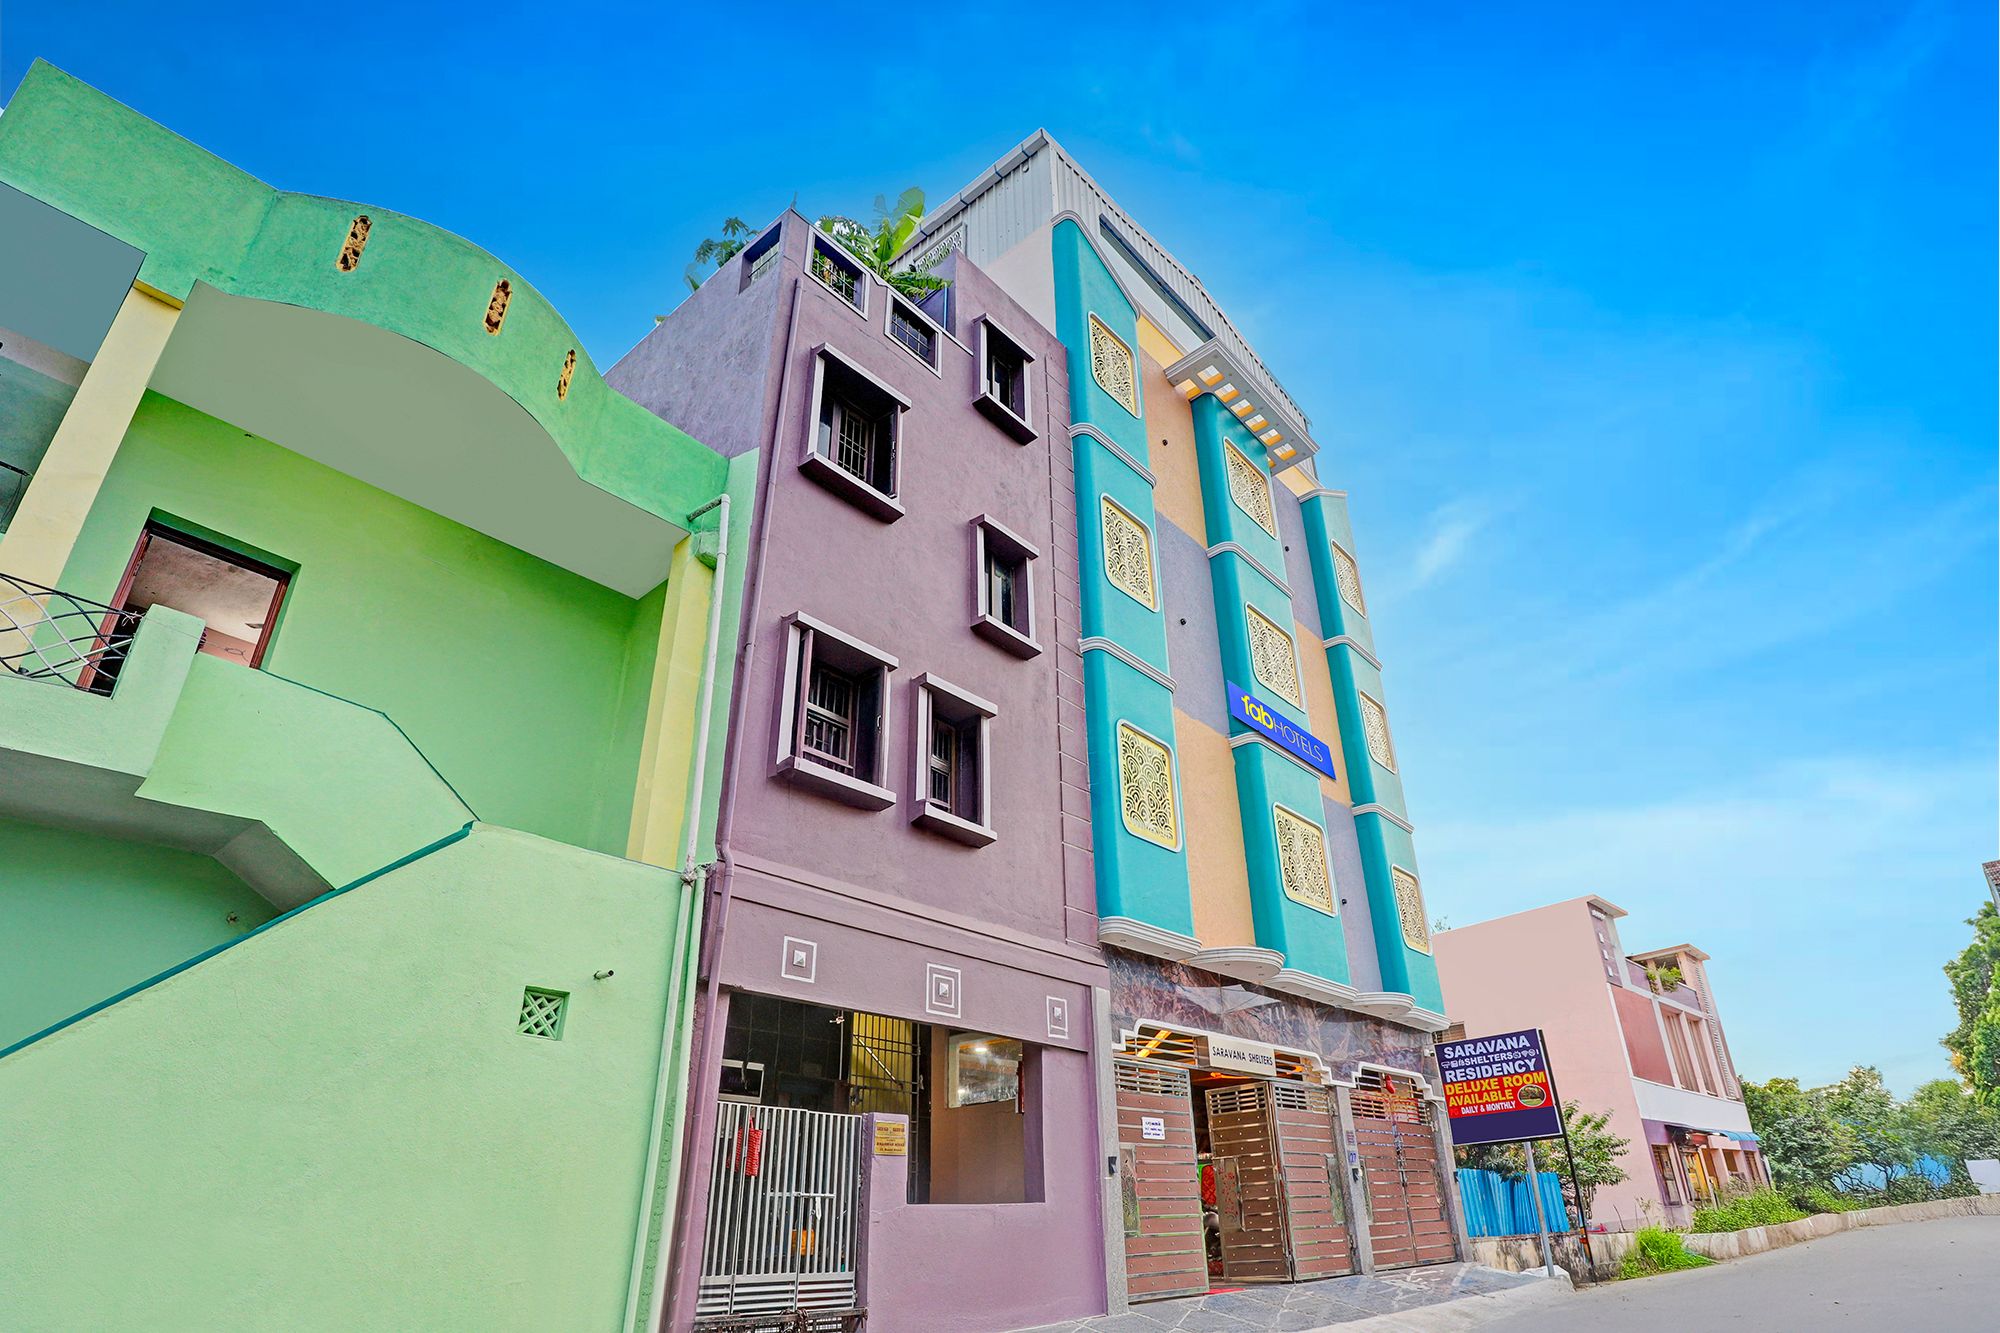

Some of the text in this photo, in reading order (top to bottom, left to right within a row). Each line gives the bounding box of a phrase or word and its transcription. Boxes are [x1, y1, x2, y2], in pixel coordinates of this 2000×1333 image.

[1212, 1046, 1273, 1066] SARAVANA SHELTERS
[1444, 1035, 1530, 1059] SARAVANA
[1464, 1051, 1513, 1066] SHELTERS
[1445, 1058, 1536, 1083] RESIDENCY
[1445, 1072, 1546, 1096] DELUXE ROOM
[1449, 1089, 1514, 1107] AVAILABLE
[1460, 1105, 1479, 1115] DAILY
[1480, 1104, 1486, 1113] &
[1486, 1101, 1516, 1112] MONTHLY
